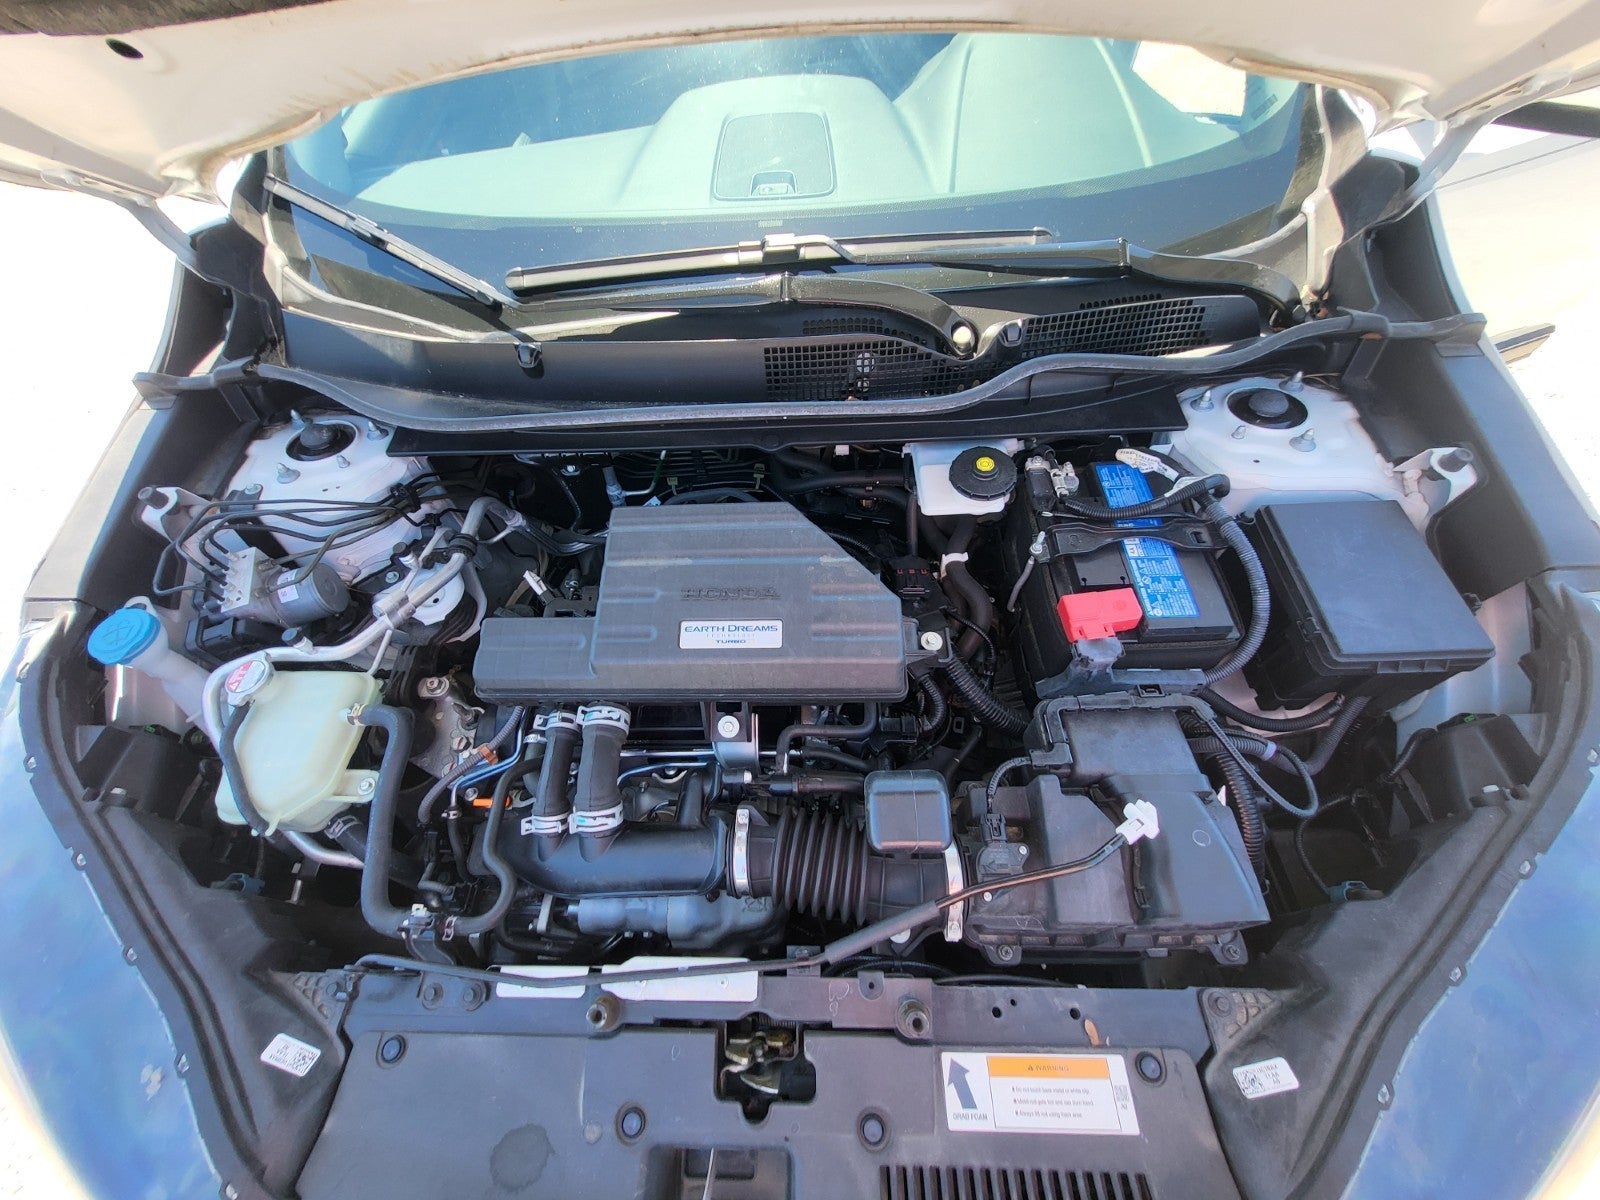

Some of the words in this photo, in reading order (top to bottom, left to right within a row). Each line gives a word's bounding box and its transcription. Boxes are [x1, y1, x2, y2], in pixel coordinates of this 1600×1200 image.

[681, 586, 782, 600] HONDA
[684, 625, 725, 633] EARTH
[727, 624, 778, 633] DREAMS
